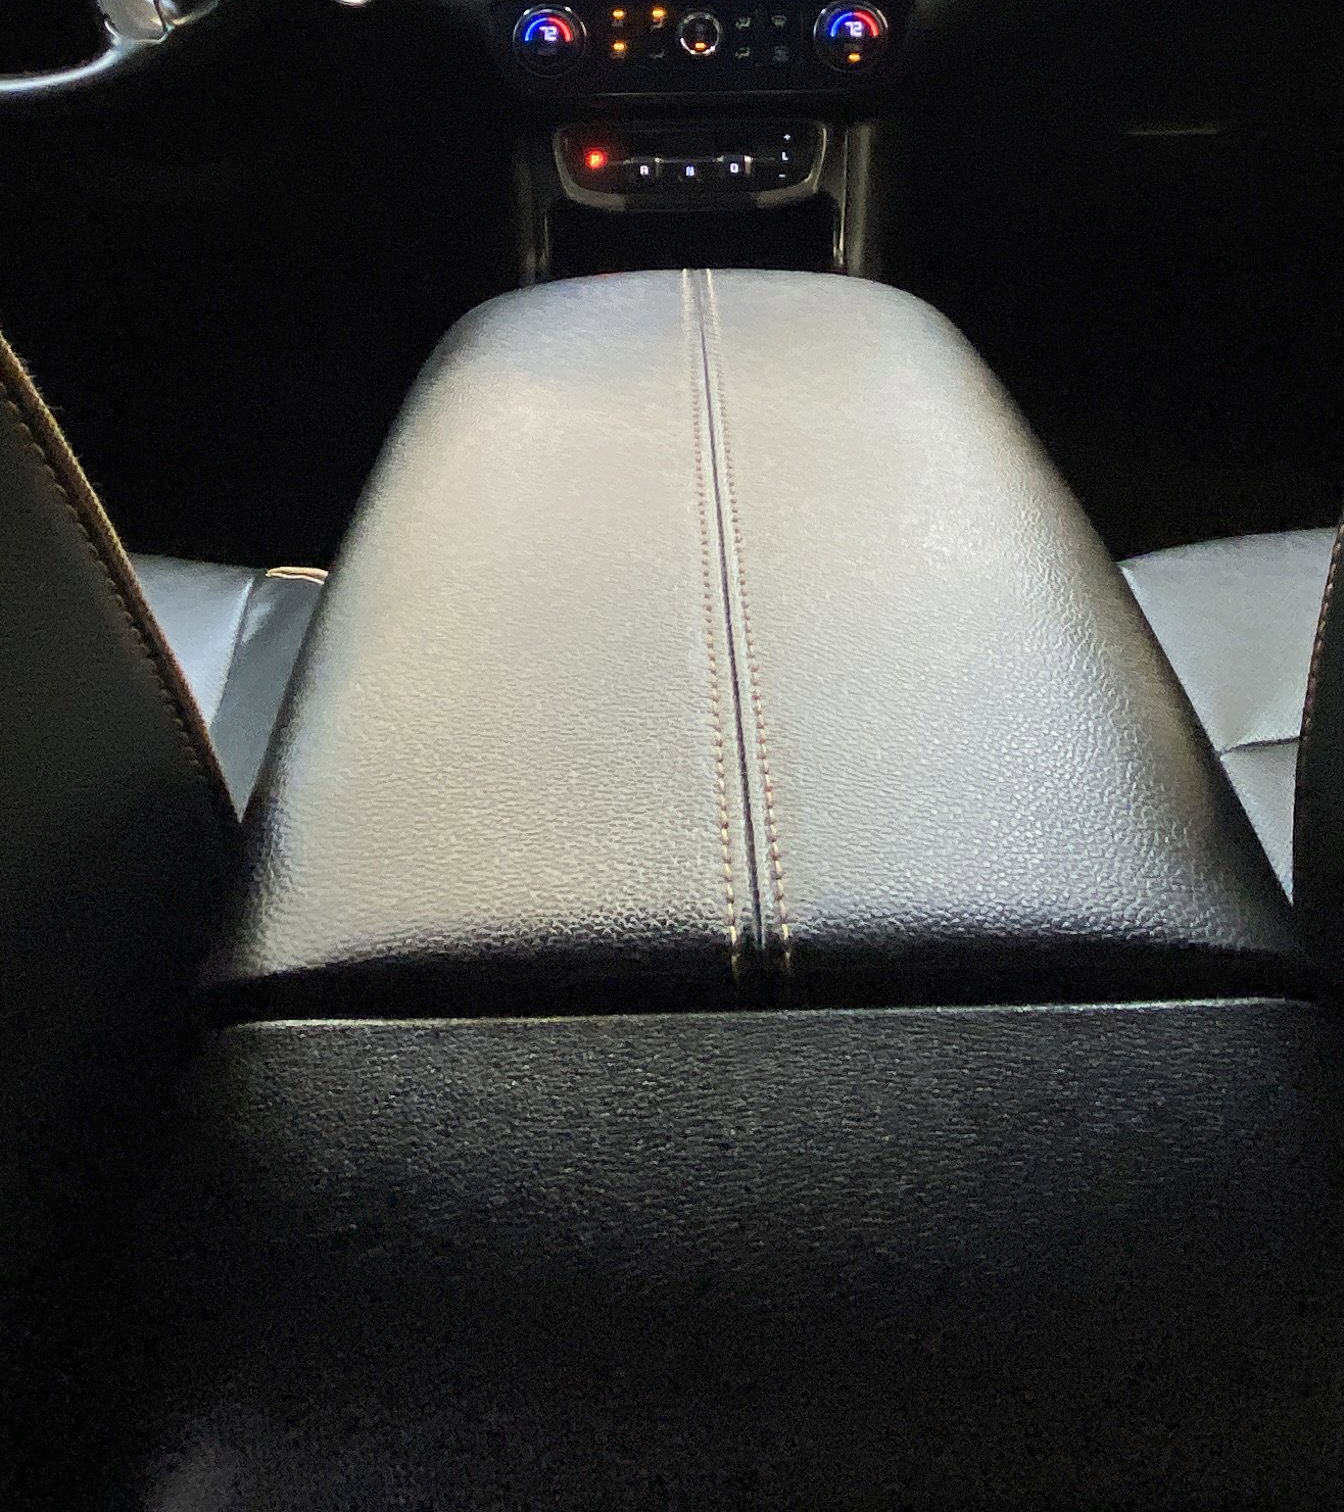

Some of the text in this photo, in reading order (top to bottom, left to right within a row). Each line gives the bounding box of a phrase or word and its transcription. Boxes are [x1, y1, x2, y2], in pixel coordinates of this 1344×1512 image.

[538, 26, 558, 42] 72
[844, 20, 863, 38] 72
[781, 151, 789, 161] L
